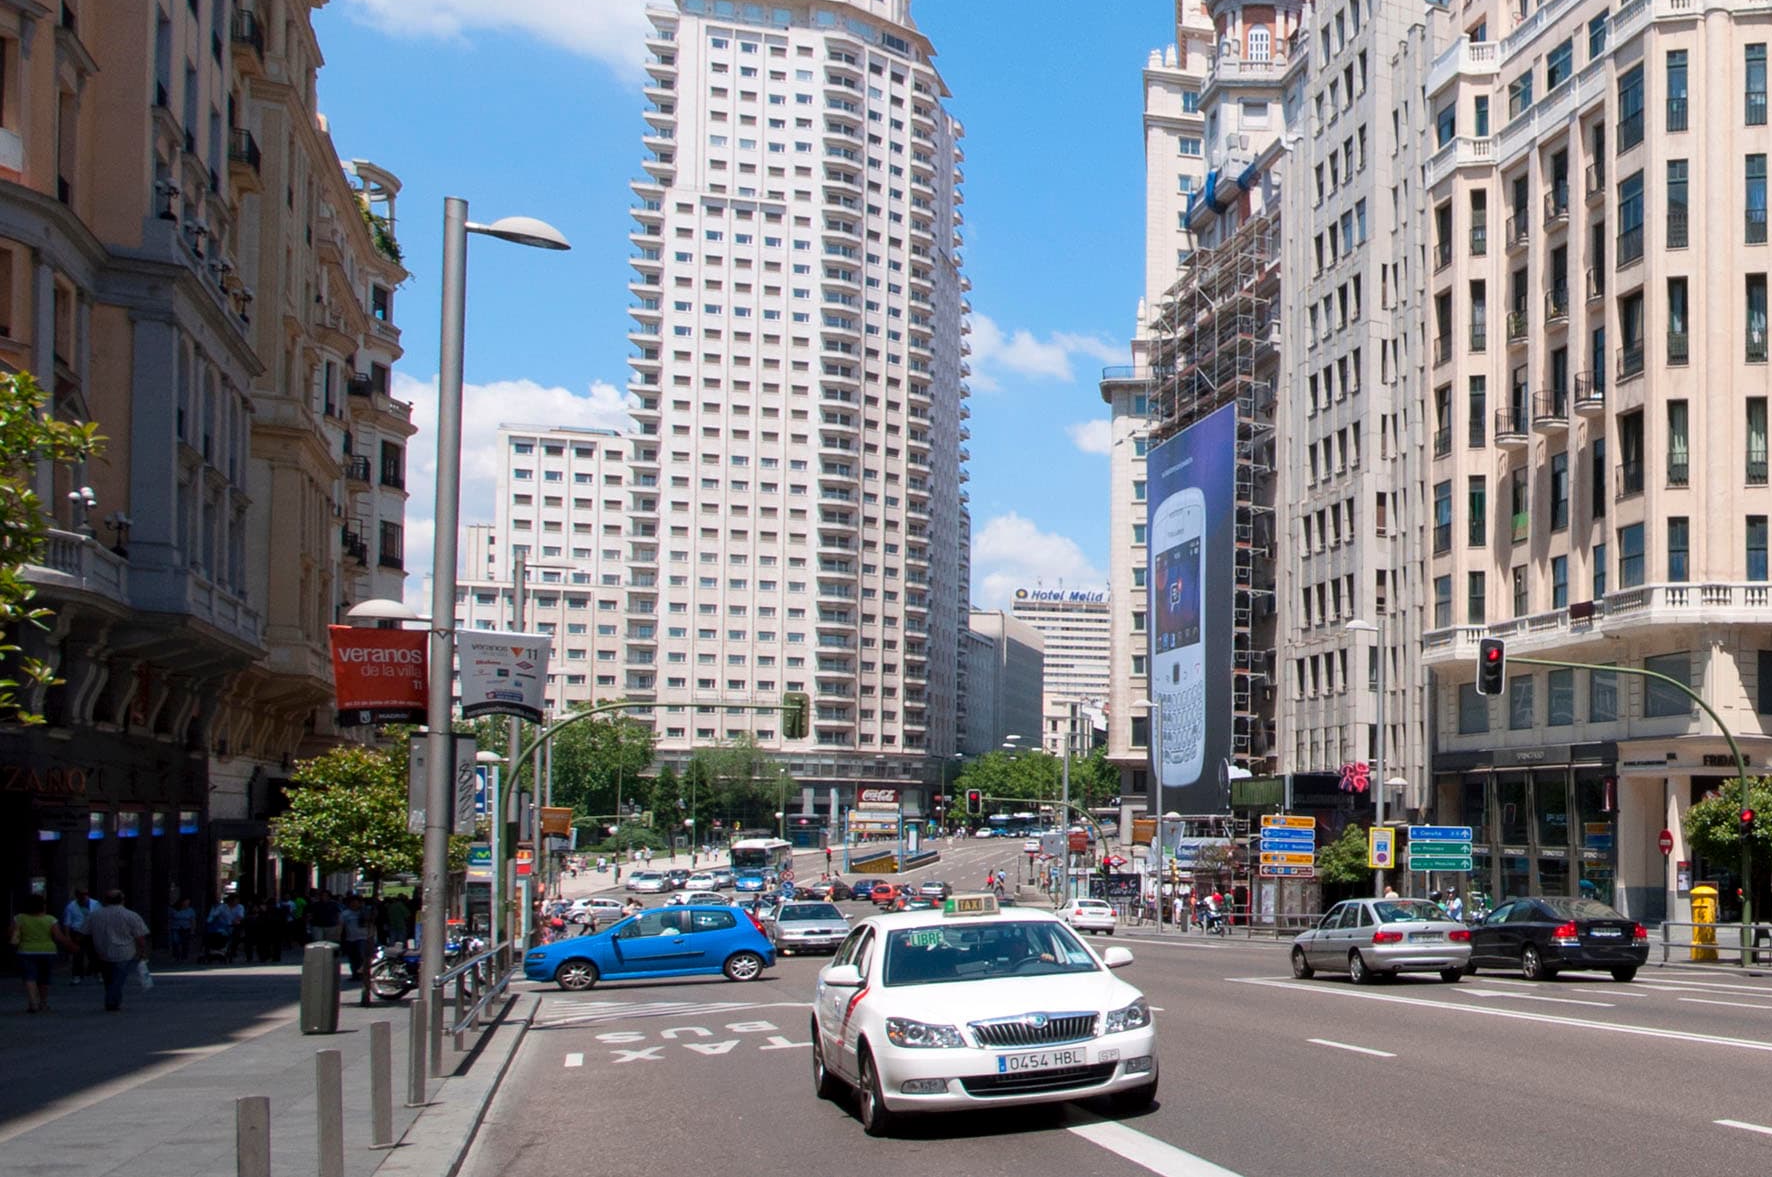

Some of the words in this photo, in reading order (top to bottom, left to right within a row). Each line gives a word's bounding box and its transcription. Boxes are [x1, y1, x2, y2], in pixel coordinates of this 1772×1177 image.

[1031, 590, 1065, 601] Hotel
[338, 647, 423, 664] veranos
[361, 664, 379, 677] de
[382, 664, 395, 677] la
[398, 665, 423, 678] villa
[960, 897, 983, 912] TAXI
[910, 932, 943, 946] LIBRE
[595, 1020, 779, 1044] BUS
[564, 1035, 815, 1067] TAXI
[1101, 1050, 1118, 1062] SP
[1010, 1054, 1049, 1070] 0454
[1054, 1049, 1082, 1065] HBL
